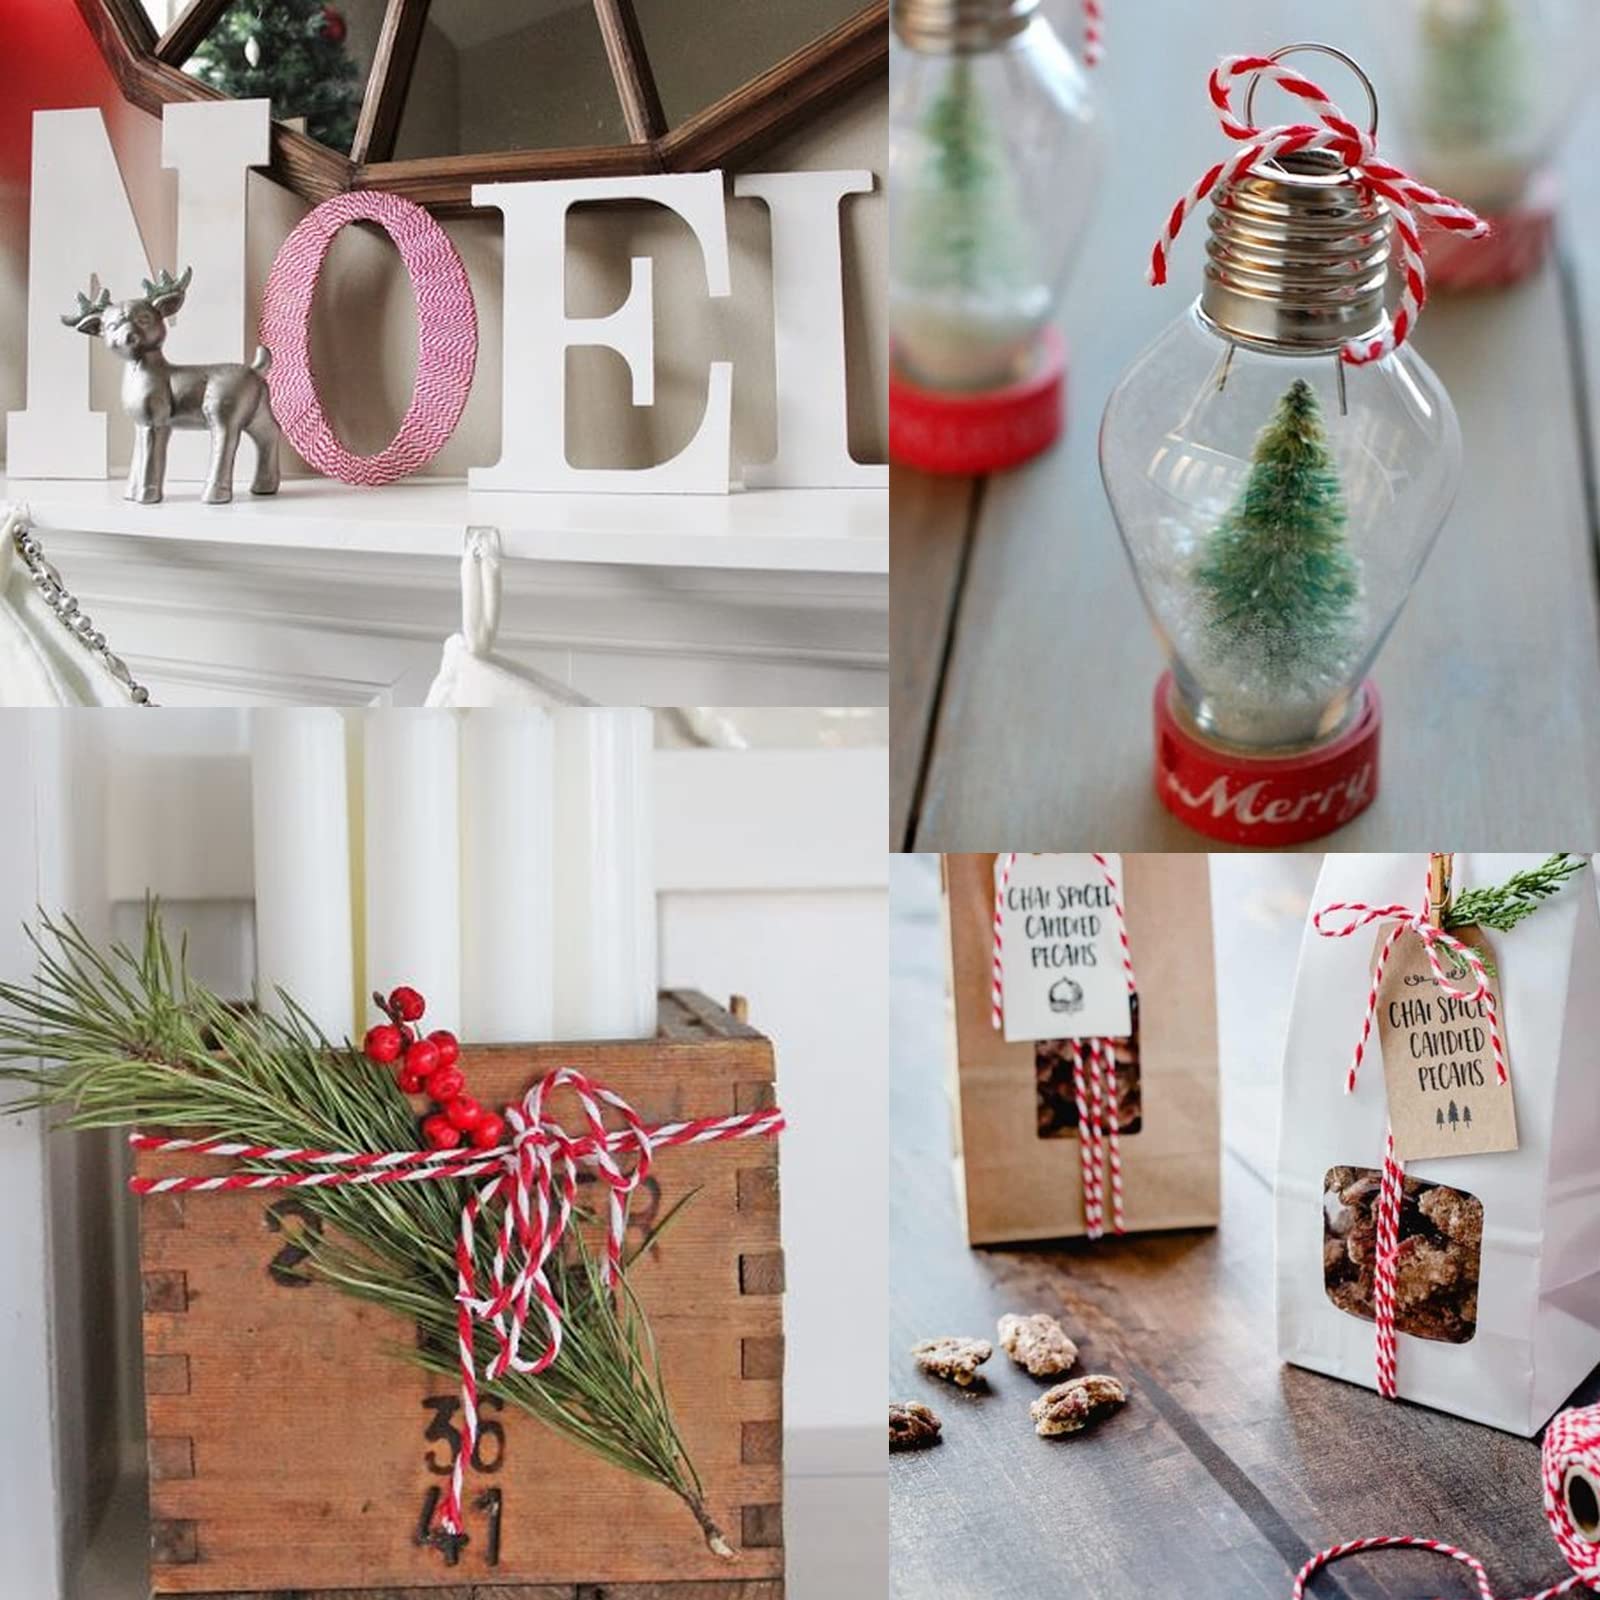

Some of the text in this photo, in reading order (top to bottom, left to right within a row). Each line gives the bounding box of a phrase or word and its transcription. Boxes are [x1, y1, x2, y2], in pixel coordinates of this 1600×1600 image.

[1167, 762, 1372, 824] Merry
[1007, 886, 1050, 911] CHAI
[1025, 914, 1101, 940] CANDIED
[1031, 943, 1097, 969] PECANS
[1389, 998, 1432, 1029] CHAI
[1409, 1026, 1485, 1059] CANDIED
[1418, 1059, 1485, 1092] PECANS
[422, 1395, 506, 1475] 36
[413, 1486, 503, 1567] 41
